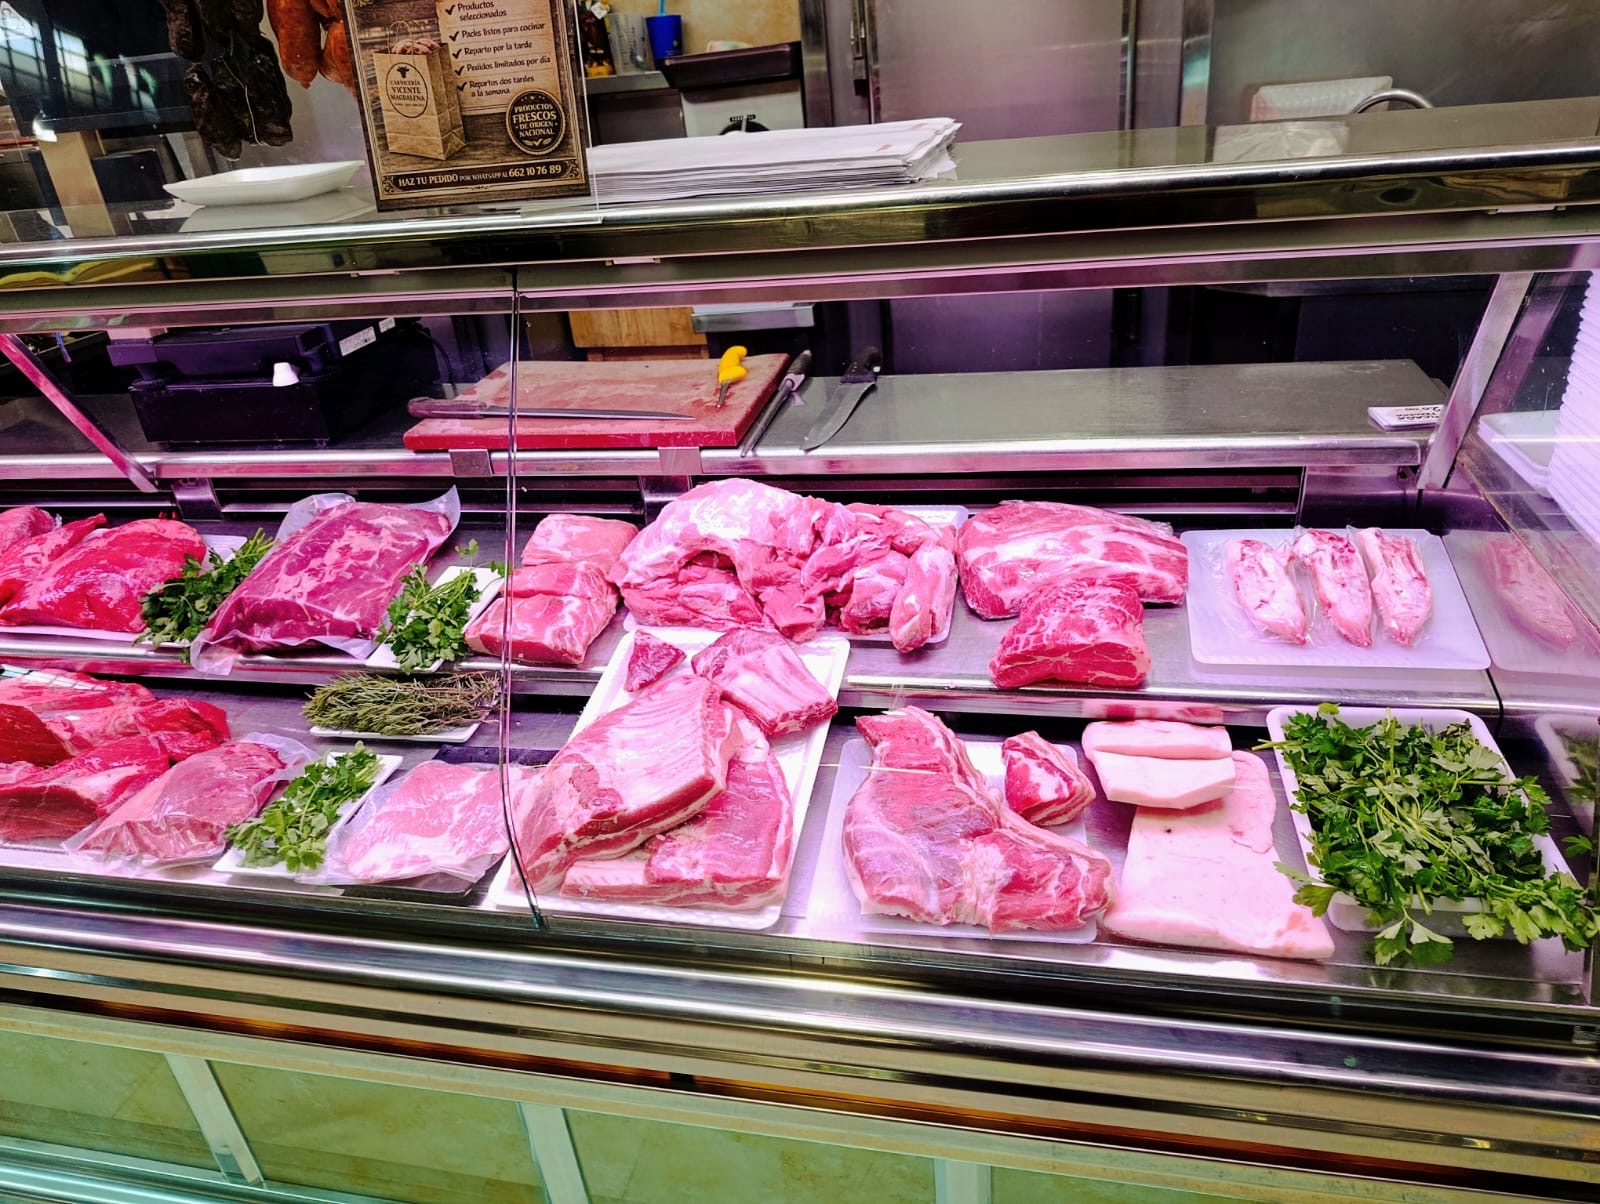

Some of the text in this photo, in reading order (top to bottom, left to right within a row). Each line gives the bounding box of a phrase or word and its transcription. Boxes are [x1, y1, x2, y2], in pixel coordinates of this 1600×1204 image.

[458, 1, 494, 12] Productos
[459, 9, 506, 21] seleccionados
[462, 22, 545, 38] Packs listos para cocinar
[464, 46, 492, 56] Reparto
[493, 45, 504, 54] por
[514, 41, 532, 49] tarde
[466, 63, 493, 72] Pedidos
[494, 60, 525, 69] limitados
[526, 58, 538, 67] por
[470, 80, 498, 89] Repartos
[513, 75, 534, 83] tardes
[485, 88, 510, 96] semana
[514, 104, 554, 113] PRODUCTOS
[512, 110, 557, 124] FRESCOS
[520, 128, 555, 138] NACIONAL
[398, 178, 416, 186] HAZ
[416, 176, 428, 184] TU
[429, 174, 458, 184] PEDIDO
[508, 168, 526, 178] 662
[526, 166, 536, 176] 10
[536, 166, 548, 174] 76
[549, 164, 562, 174] 89
